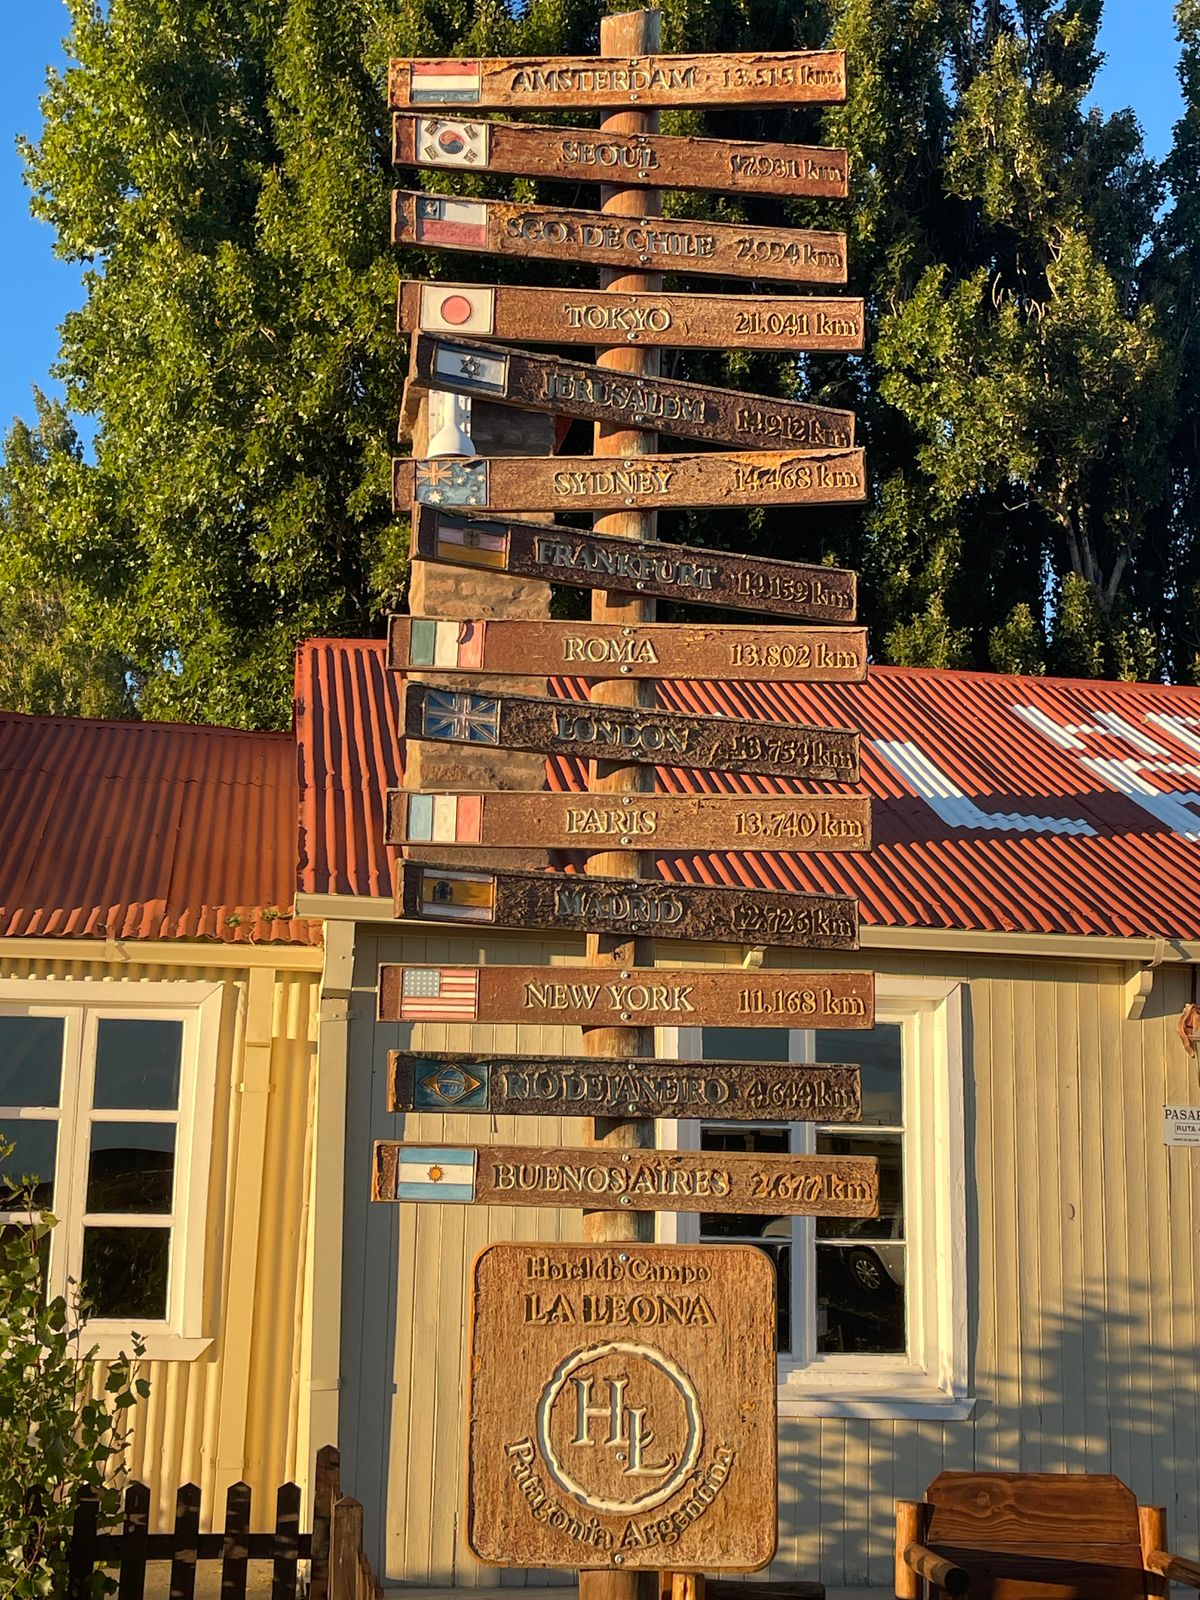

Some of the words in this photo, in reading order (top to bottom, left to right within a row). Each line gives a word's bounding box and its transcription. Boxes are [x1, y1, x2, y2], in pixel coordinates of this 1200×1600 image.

[511, 67, 697, 92] AMSTERDAM
[723, 67, 794, 88] 13.515
[801, 65, 841, 86] km
[561, 141, 660, 170] SEOUL
[730, 155, 800, 179] 17.931
[802, 159, 845, 182] km
[581, 225, 623, 250] DE
[625, 229, 714, 258] CHILE
[803, 243, 843, 268] km
[564, 303, 671, 332] TOKYO
[734, 312, 810, 337] 21.041
[815, 312, 858, 337] km
[541, 372, 706, 424] JERUSALEM
[809, 417, 851, 448] km
[553, 471, 673, 496] SYDNEY
[735, 466, 812, 491] 14.468
[816, 464, 859, 488] km
[534, 537, 717, 589] FRANKFURT
[812, 579, 852, 609] km
[563, 637, 659, 663] ROMA
[730, 643, 811, 668] 13.802
[815, 643, 860, 668] km
[554, 713, 689, 752] LONDON
[813, 741, 857, 769] km
[566, 808, 658, 834] PARIS
[735, 812, 817, 838] 13.740
[820, 812, 863, 838] km
[555, 889, 683, 923] MADRID
[813, 908, 854, 937] km
[524, 983, 600, 1009] NEW
[604, 984, 695, 1012] YORK
[738, 989, 816, 1015] 11.168
[820, 988, 866, 1016] km
[504, 1071, 560, 1099] RIO
[564, 1072, 606, 1101] DE
[607, 1074, 730, 1106] JANEIRO
[815, 1080, 857, 1108] km
[492, 1163, 629, 1194] BUENOS
[629, 1165, 732, 1197] AIRES
[825, 1174, 872, 1200] km
[526, 1255, 593, 1281] Hotel
[595, 1255, 625, 1281] de
[627, 1257, 712, 1285] Campo
[524, 1292, 577, 1326] LA
[582, 1292, 717, 1328] LEONA
[504, 1436, 614, 1550] Patagonia
[620, 1443, 736, 1550] Argentina
